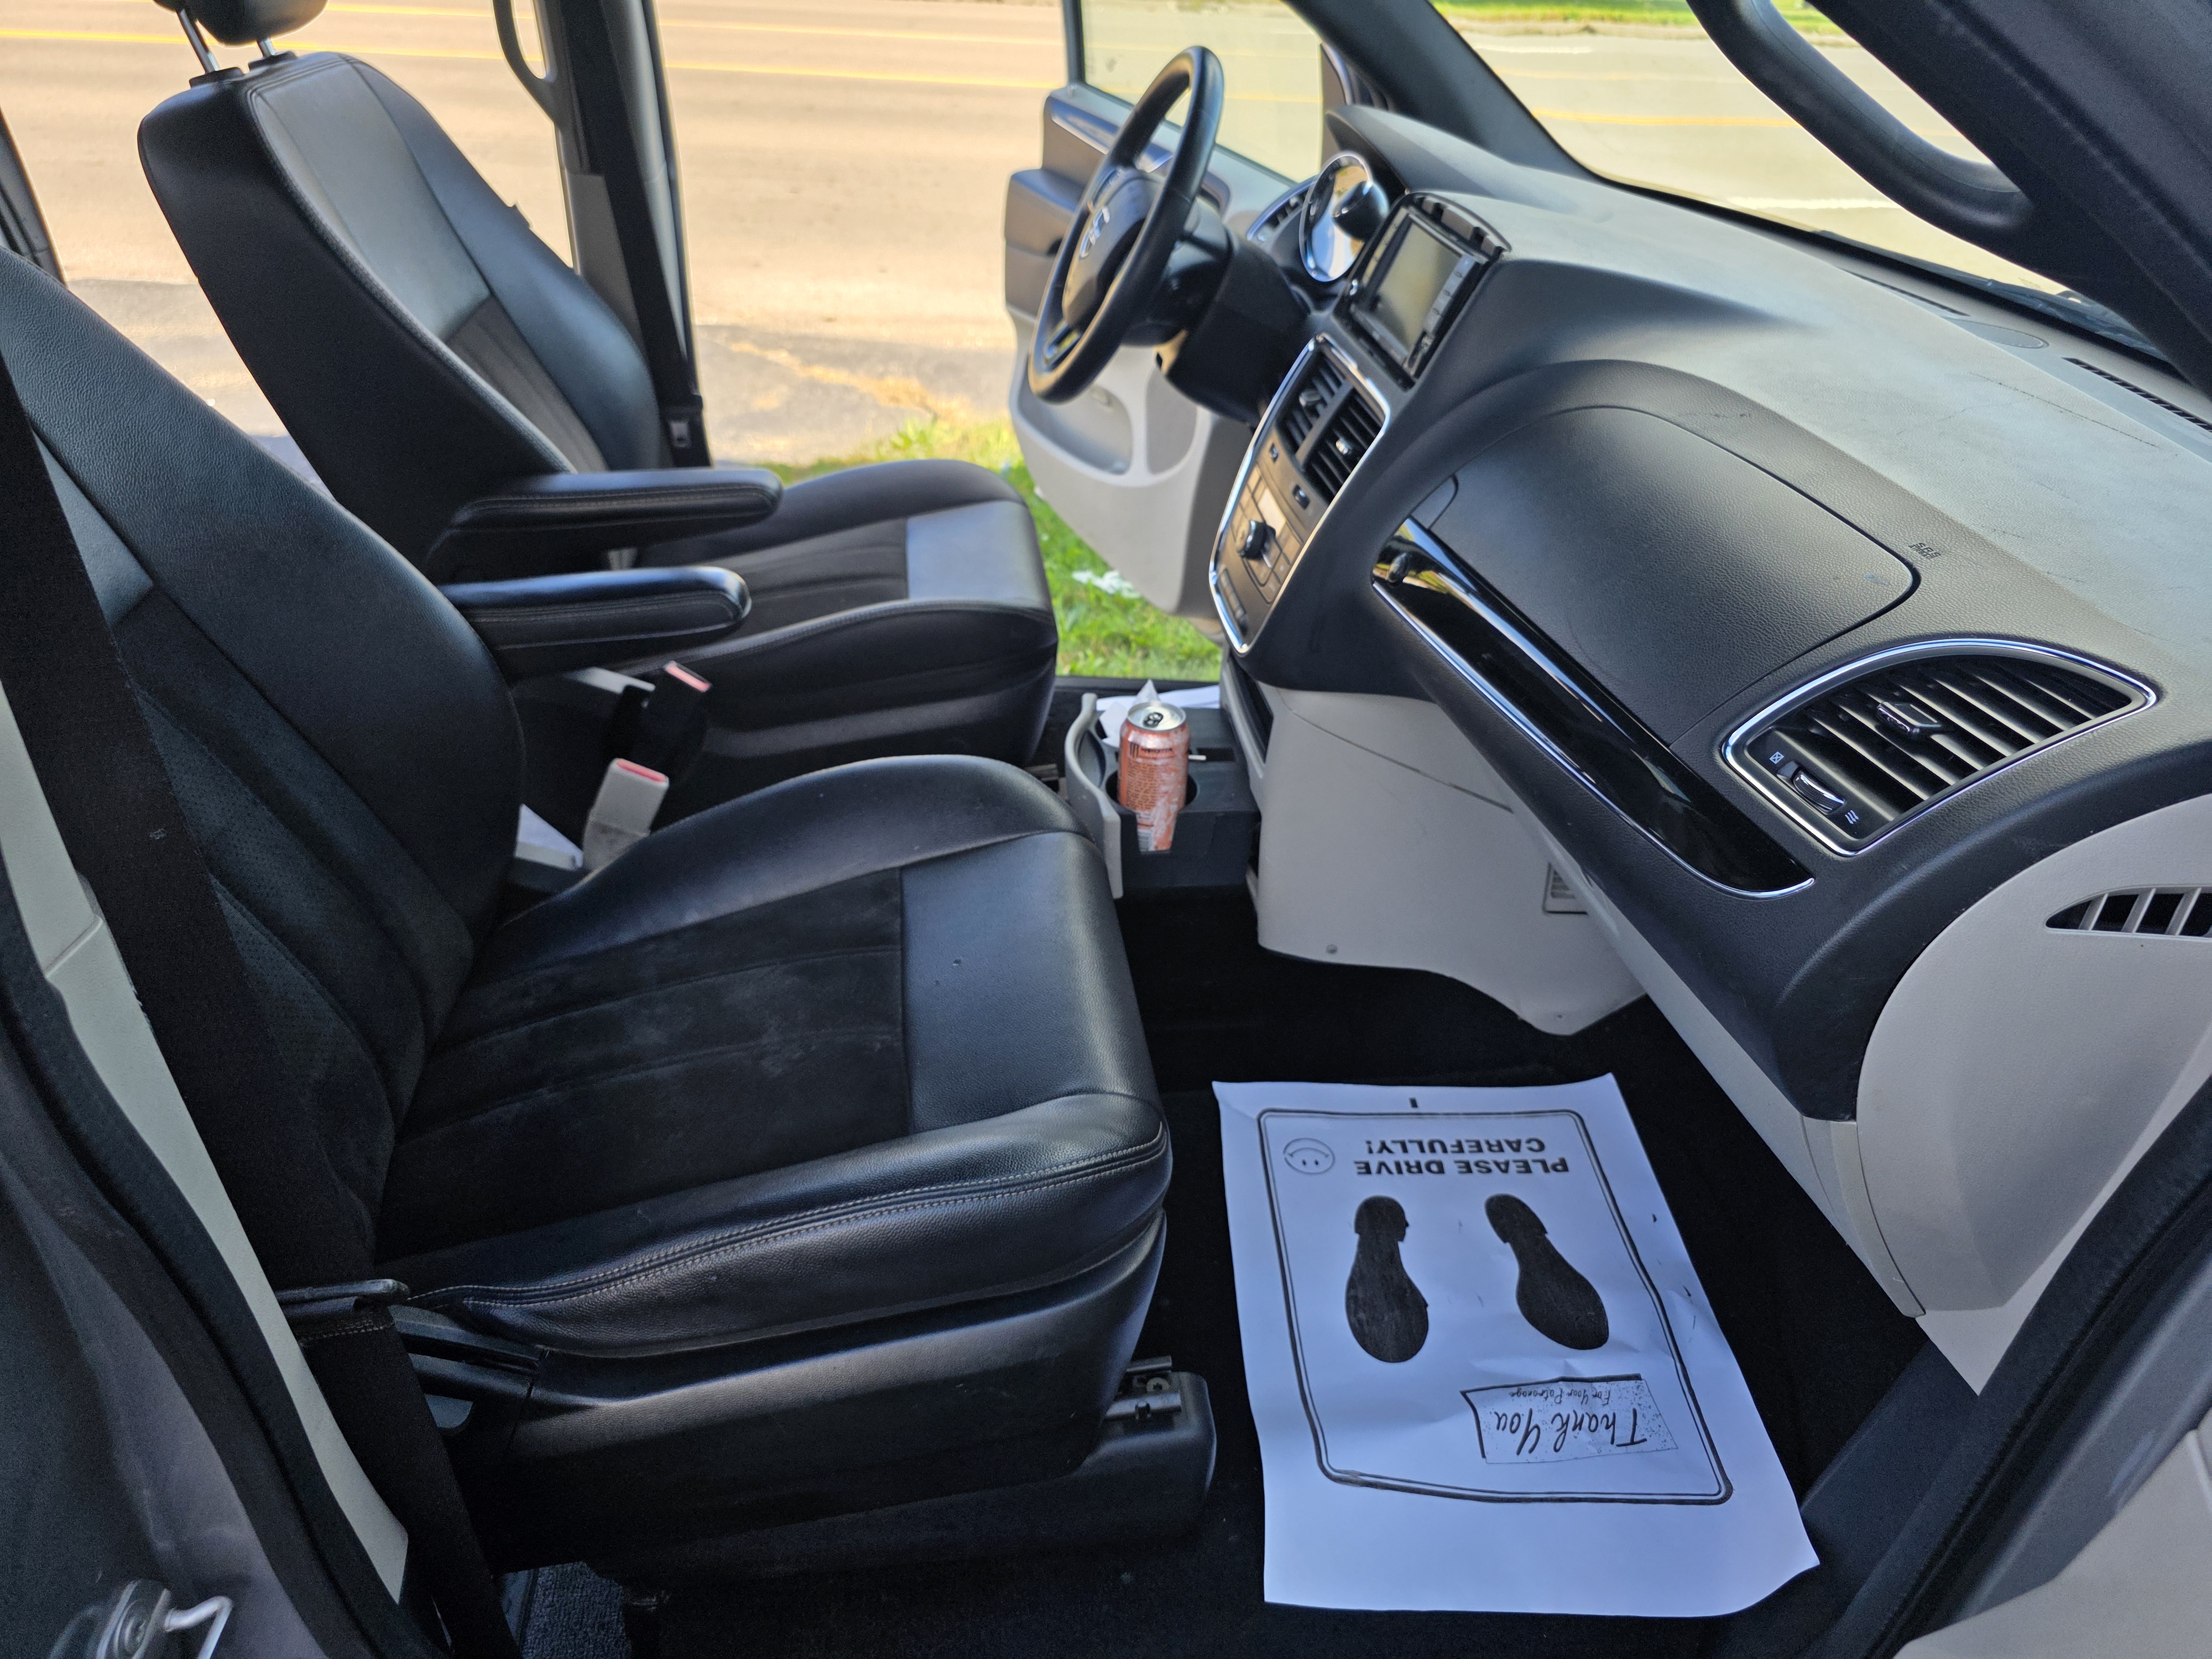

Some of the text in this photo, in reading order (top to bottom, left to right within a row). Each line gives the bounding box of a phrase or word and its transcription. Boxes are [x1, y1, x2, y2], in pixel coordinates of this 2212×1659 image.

[1908, 545, 1933, 560] AIRBAG
[1916, 542, 1941, 557] SRS
[1365, 1138, 1546, 1155] CAREFULLY!
[1354, 1157, 1569, 1175] PLEASE DRIVE
[1509, 1388, 1611, 1406] For Your Patronage
[1494, 1408, 1647, 1455] Thank You
